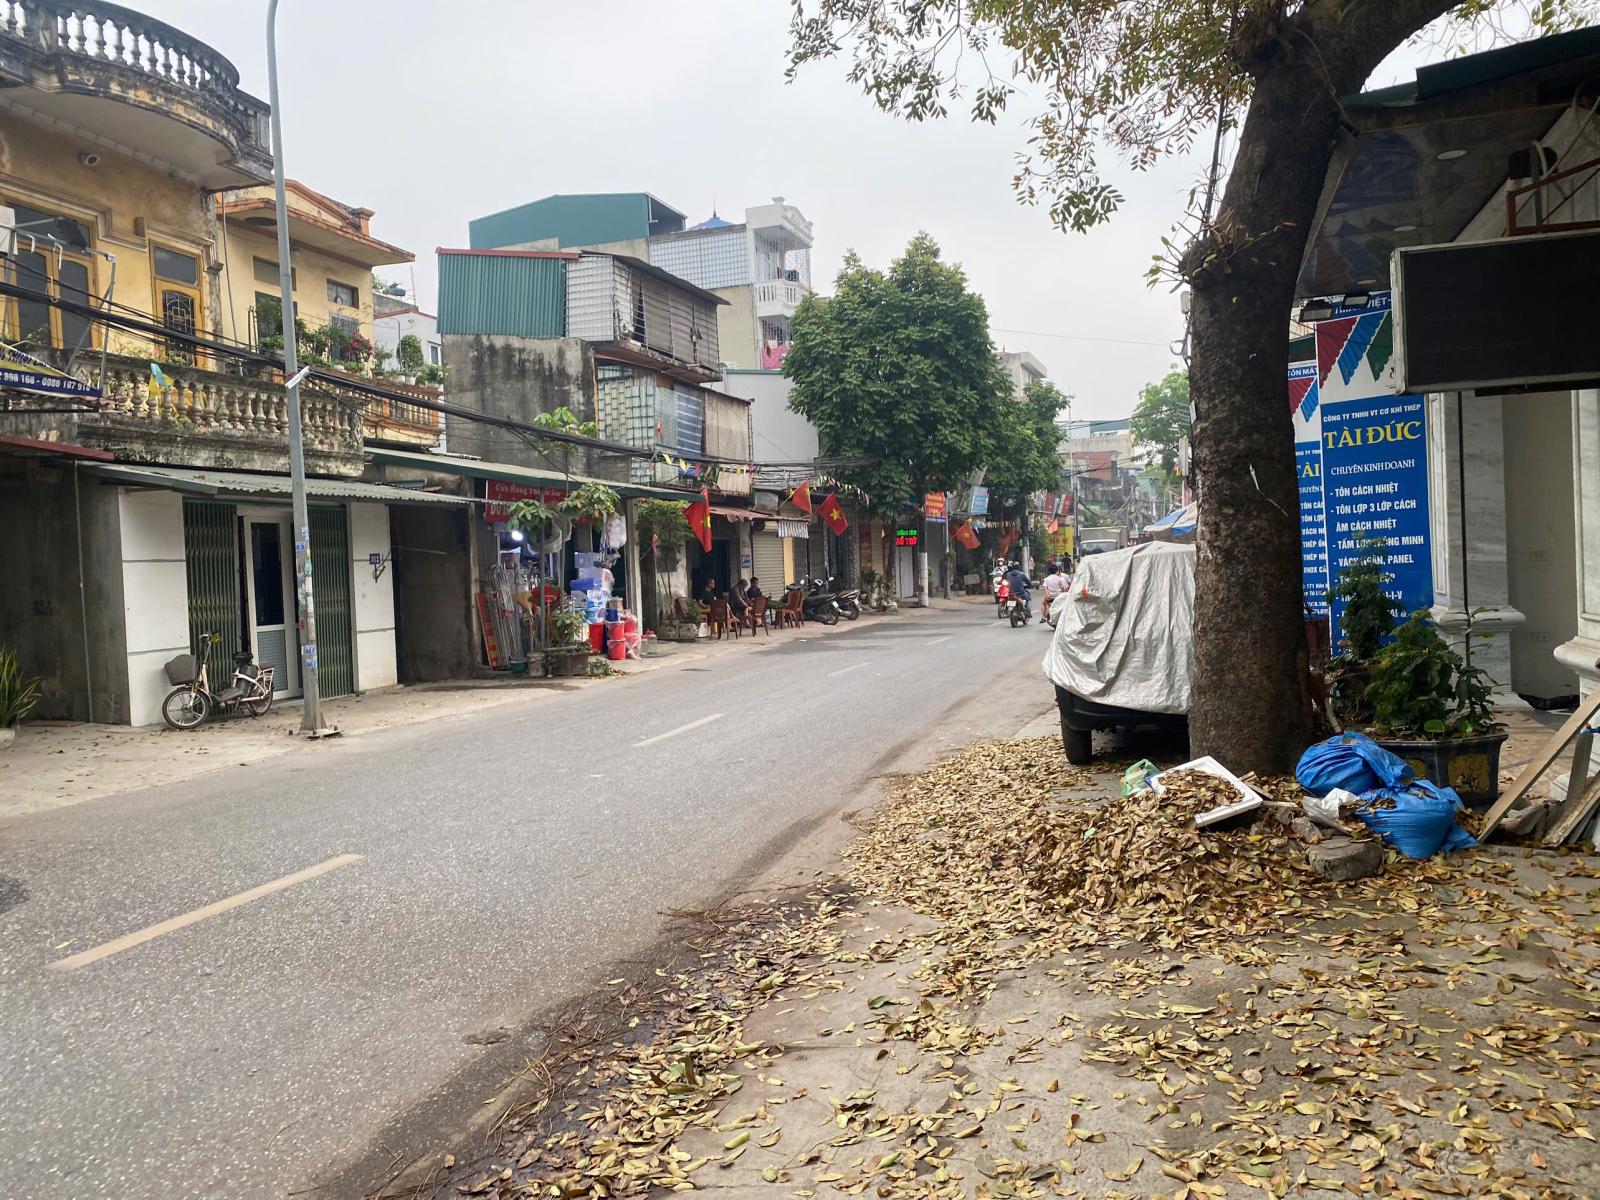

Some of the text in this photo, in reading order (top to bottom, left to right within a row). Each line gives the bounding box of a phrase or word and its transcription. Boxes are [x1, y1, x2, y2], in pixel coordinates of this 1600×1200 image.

[1323, 414, 1341, 423] CÔNG
[1351, 411, 1369, 419] TNHH
[1370, 409, 1378, 417] VT
[1380, 407, 1389, 415] CƠ
[1404, 403, 1421, 412] THÉP
[1323, 420, 1422, 449] TÀI ĐỨC
[1331, 459, 1415, 476] CHUYÊN KINH DOANH
[1335, 482, 1399, 497] TÔN CÁCH NHIỆT
[1336, 499, 1416, 515] TÔN LỢP 3 LỚP CÁCH
[1336, 518, 1397, 533] ÂM CÁCH NHIỆT
[1337, 537, 1354, 549] TẤM
[1401, 535, 1424, 546] MINH
[1387, 554, 1414, 565] PANEL
